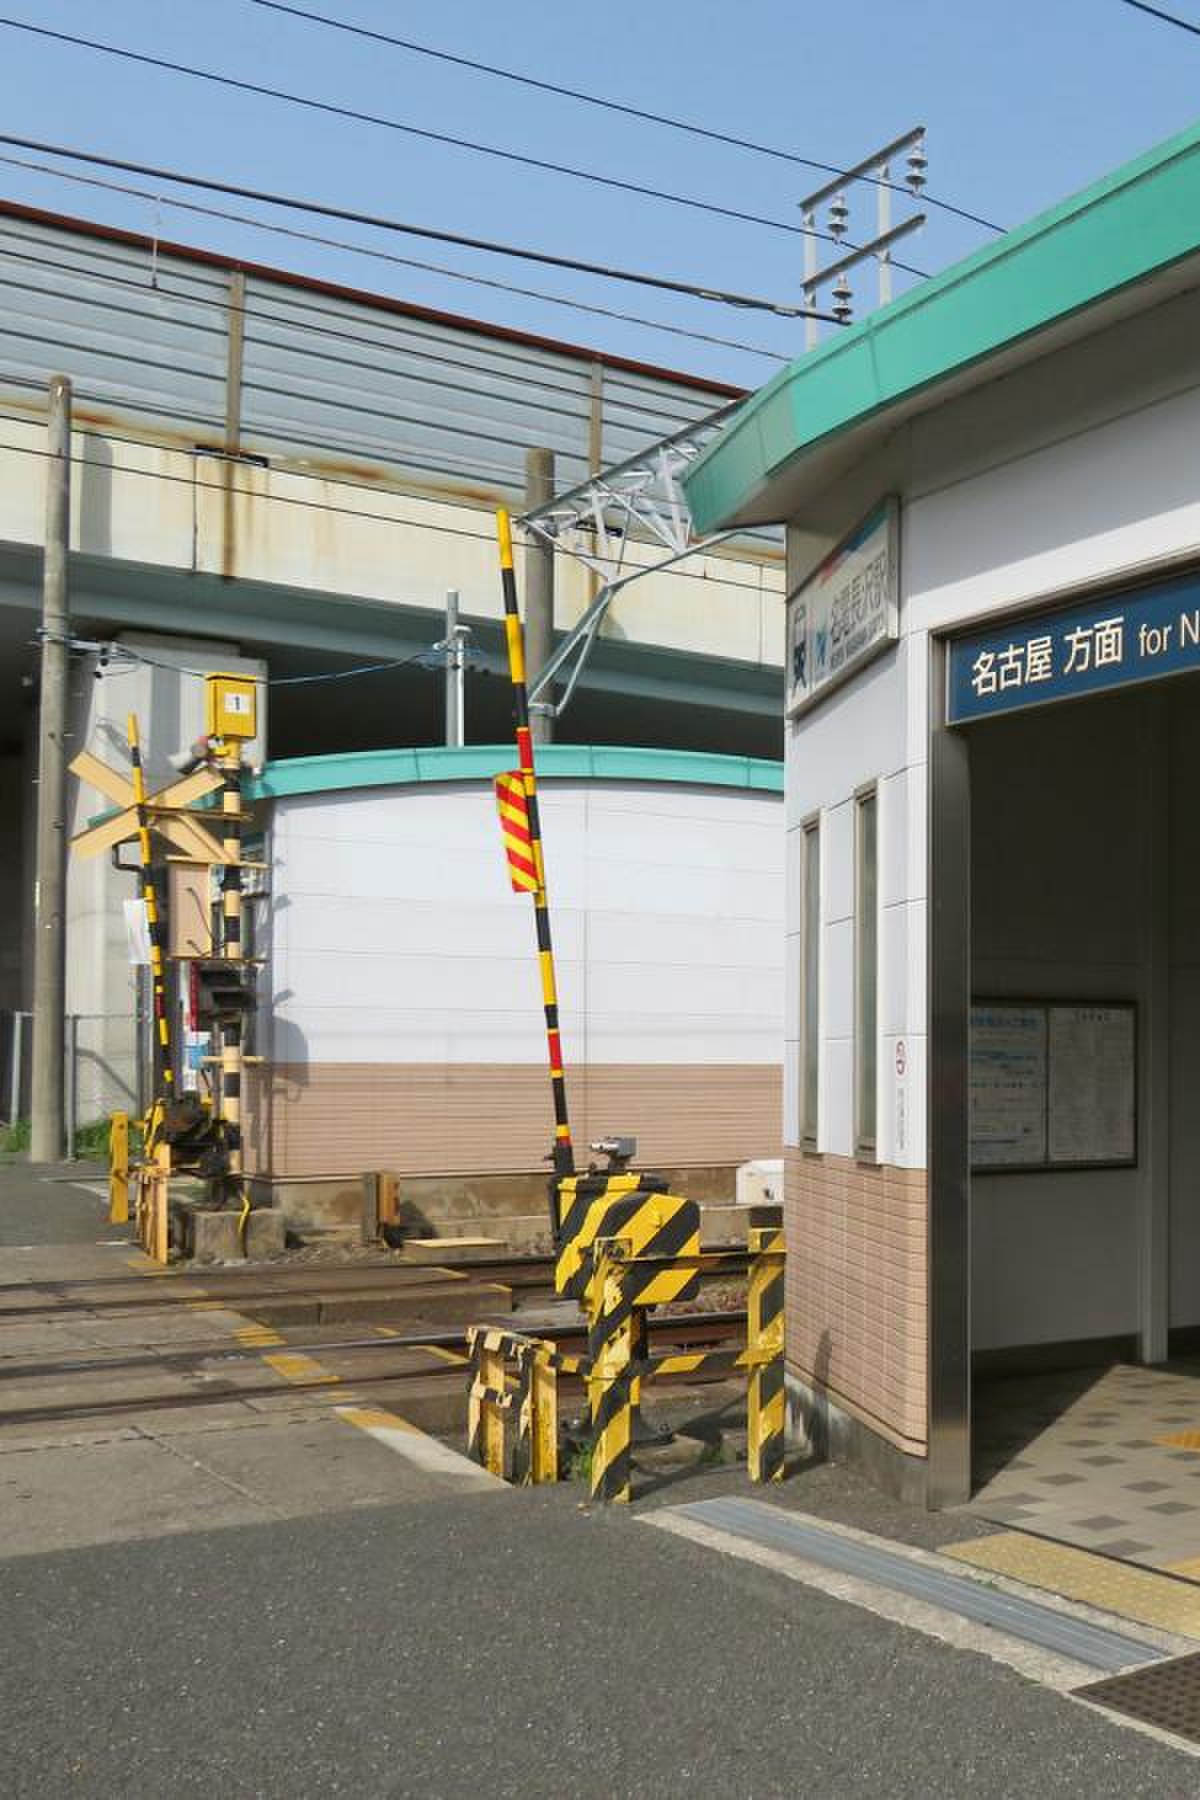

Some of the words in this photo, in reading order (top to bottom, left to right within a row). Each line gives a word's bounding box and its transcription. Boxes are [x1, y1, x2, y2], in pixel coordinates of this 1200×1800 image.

[971, 635, 1053, 697] 名古屋
[1064, 615, 1125, 674] 方面
[1139, 623, 1173, 657] for
